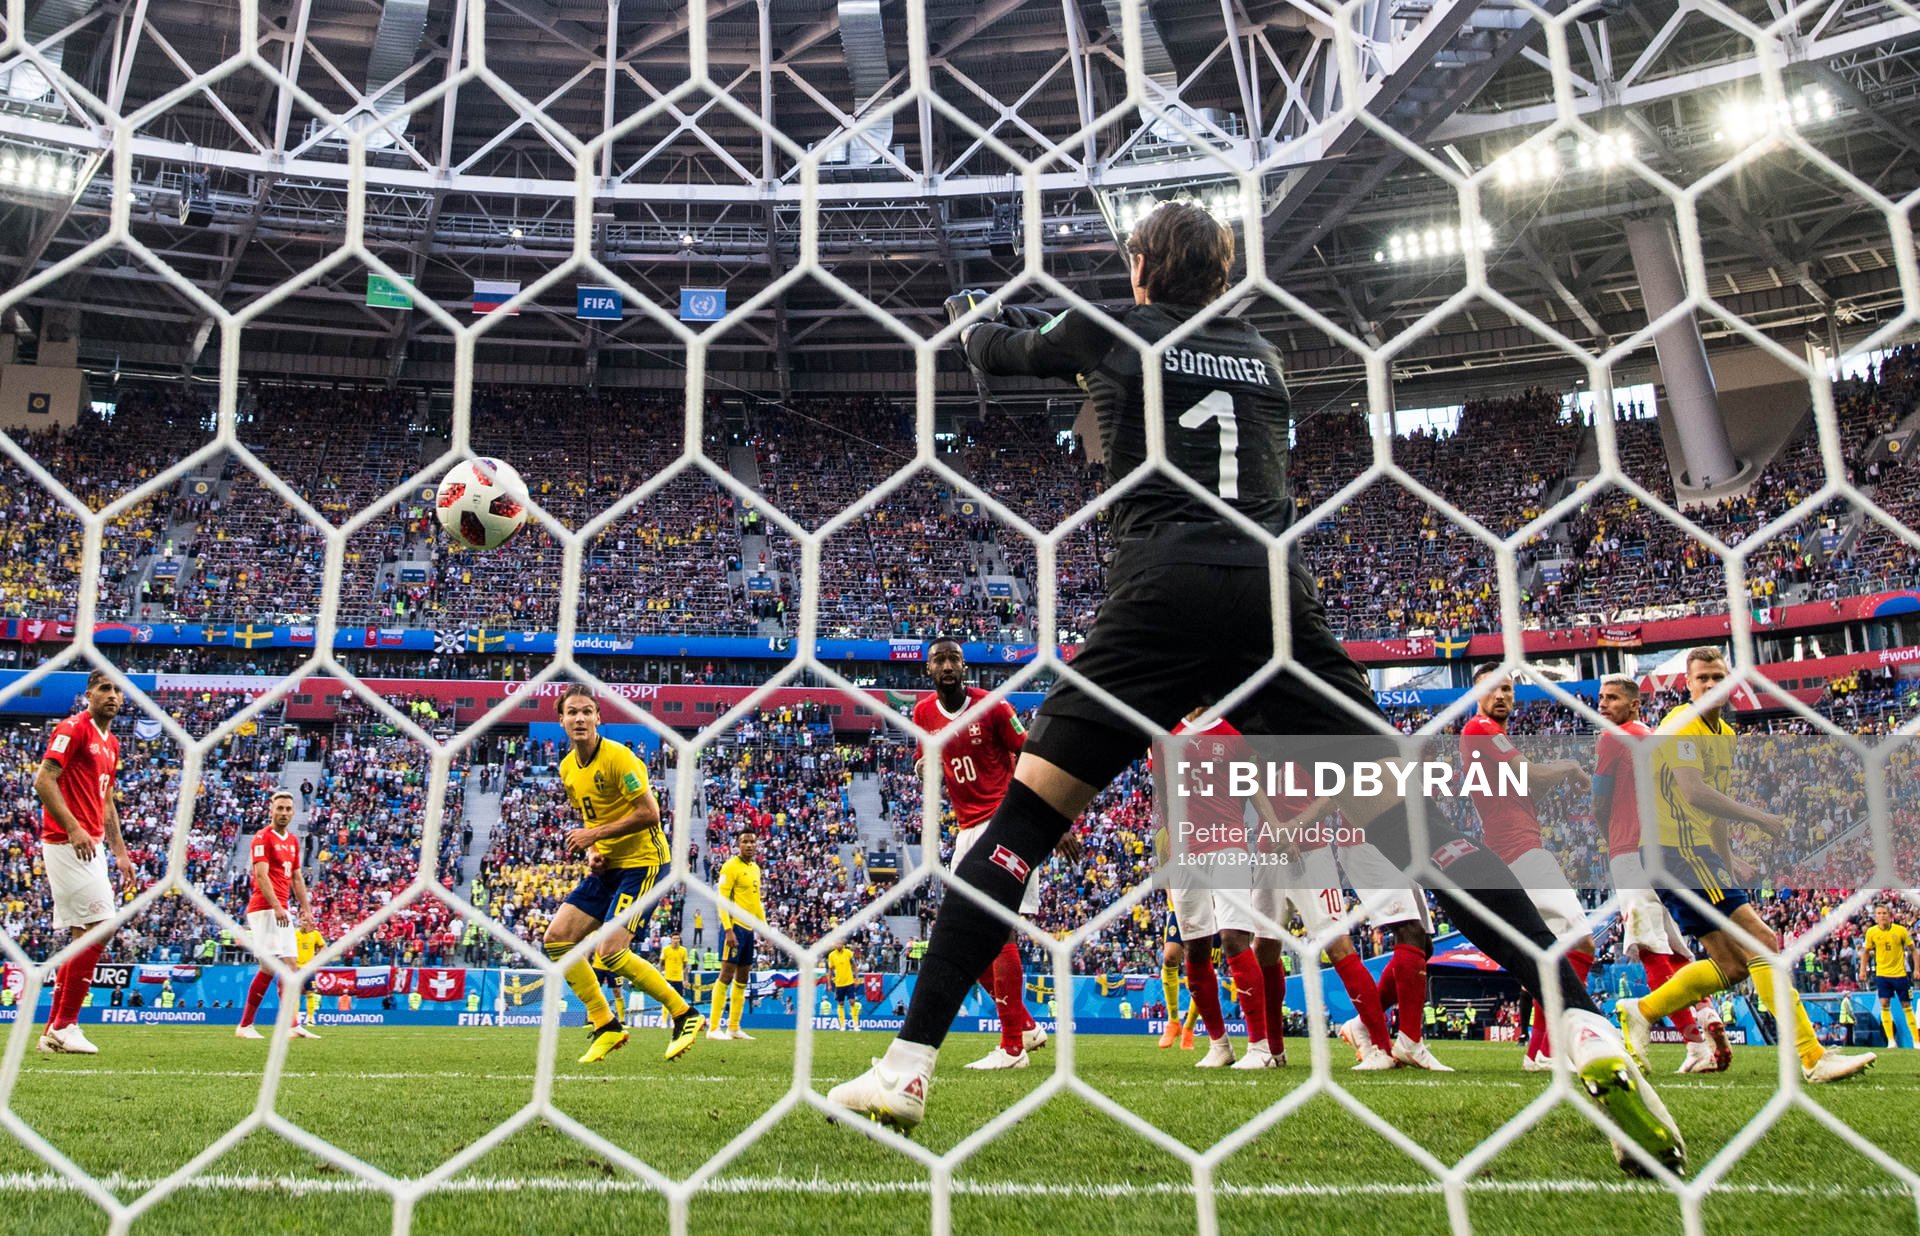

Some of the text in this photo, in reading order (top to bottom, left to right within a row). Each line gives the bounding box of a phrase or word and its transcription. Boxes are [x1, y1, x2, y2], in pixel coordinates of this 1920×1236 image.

[583, 297, 615, 310] FIFA
[1165, 345, 1270, 386] SOMMER
[1178, 389, 1239, 499] 1
[554, 637, 618, 651] orldcup
[1879, 645, 1920, 663] #worl
[1375, 690, 1421, 705] SSIA
[951, 755, 977, 784] 20
[582, 796, 597, 820] 8
[614, 892, 633, 917] 8
[1320, 888, 1342, 914] 10
[102, 1009, 205, 1022] FIFA FOUNDATION
[318, 1014, 384, 1023] FOUNDATION
[458, 1013, 493, 1026] FIFA
